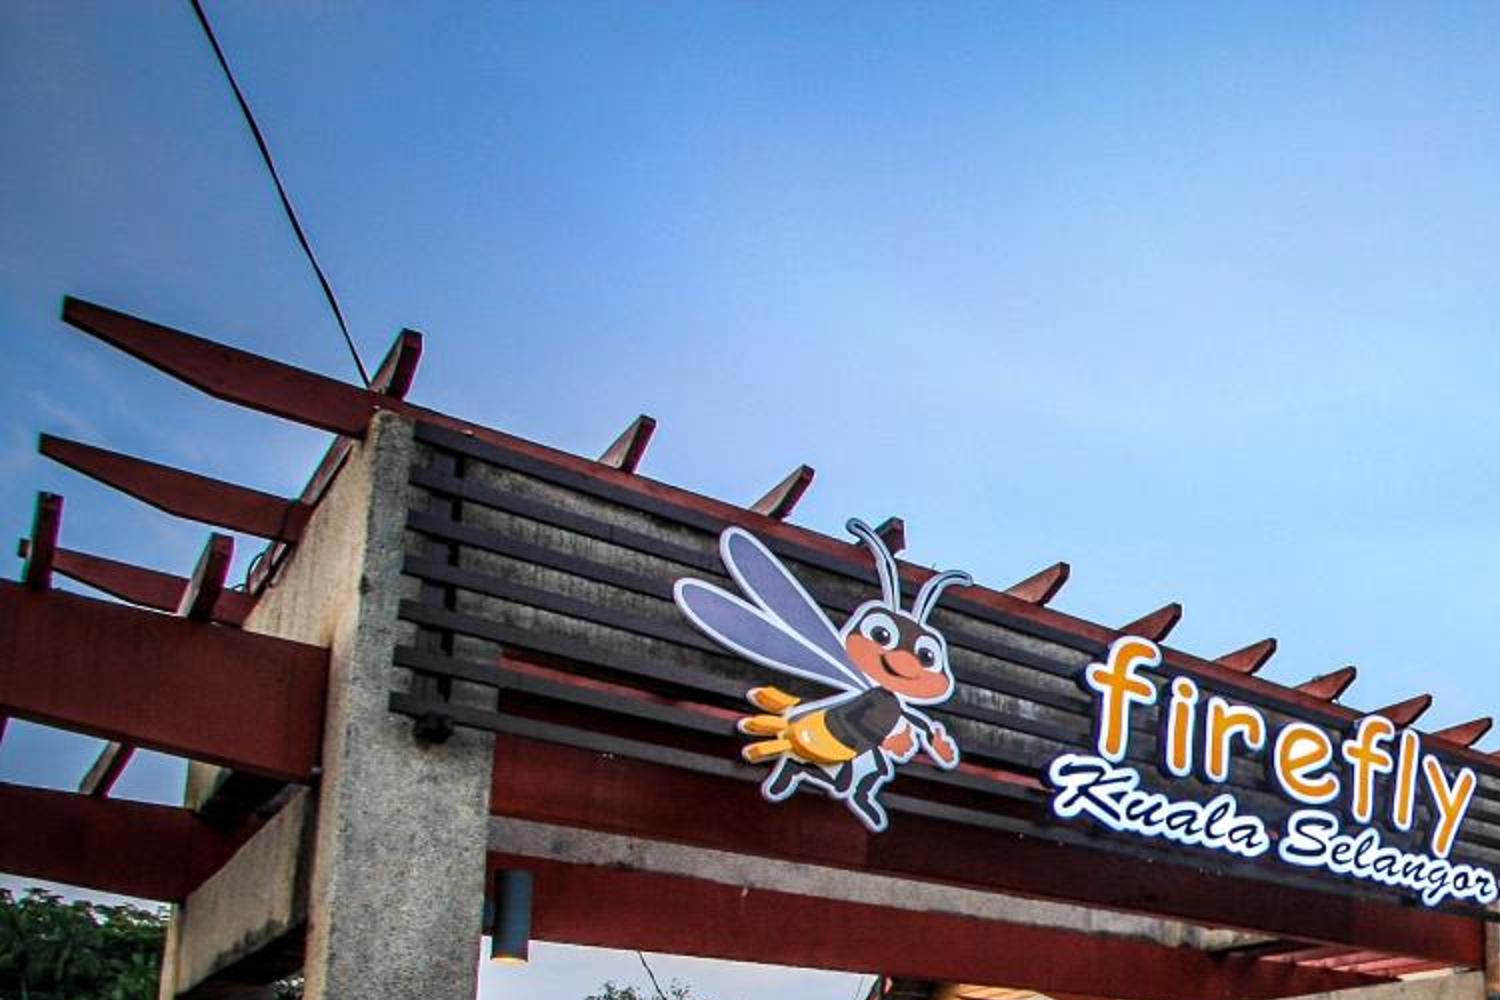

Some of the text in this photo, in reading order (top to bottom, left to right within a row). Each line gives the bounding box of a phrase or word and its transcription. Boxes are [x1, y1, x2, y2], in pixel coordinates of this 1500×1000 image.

[1051, 757, 1496, 905] Kuala Selangor
[1088, 637, 1477, 857] firefly
